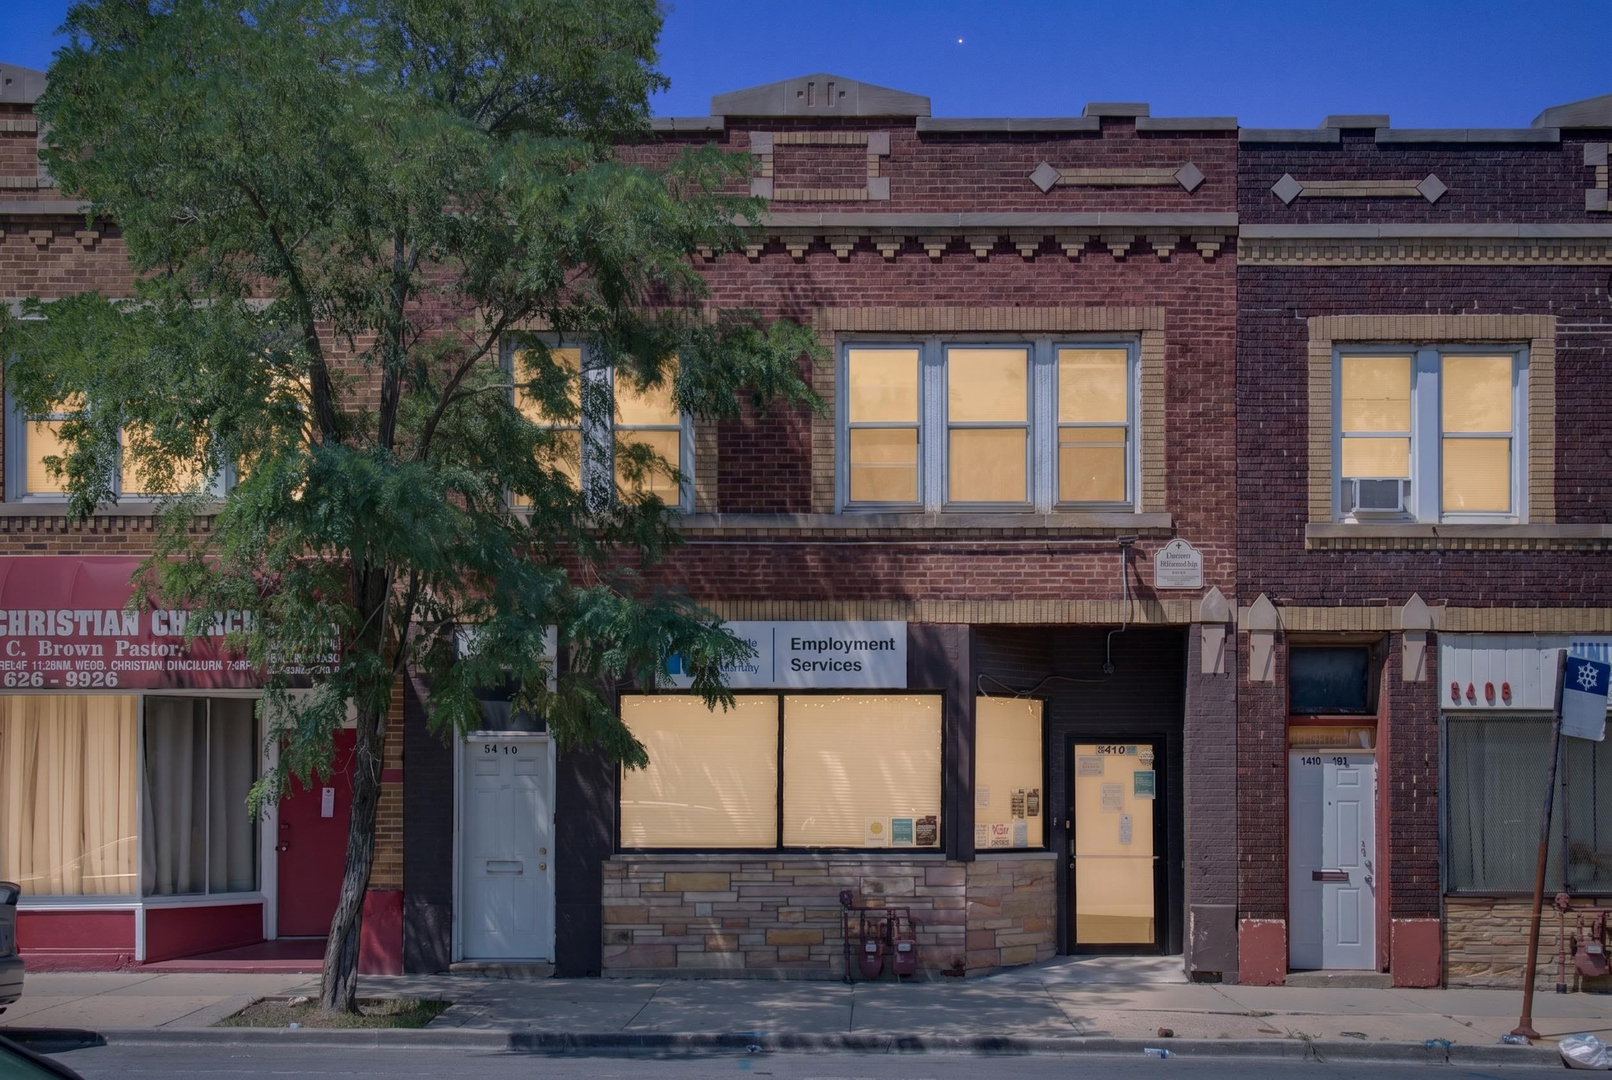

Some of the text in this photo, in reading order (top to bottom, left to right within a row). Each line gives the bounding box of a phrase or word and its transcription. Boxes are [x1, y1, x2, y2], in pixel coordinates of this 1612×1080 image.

[152, 609, 260, 637] CHRCH
[6, 640, 26, 657] C.
[38, 640, 103, 657] Brown
[790, 637, 895, 654] Employment
[790, 658, 862, 672] Services
[4, 671, 44, 687] 626
[65, 671, 118, 687] 9926
[1301, 756, 1321, 766] 1410
